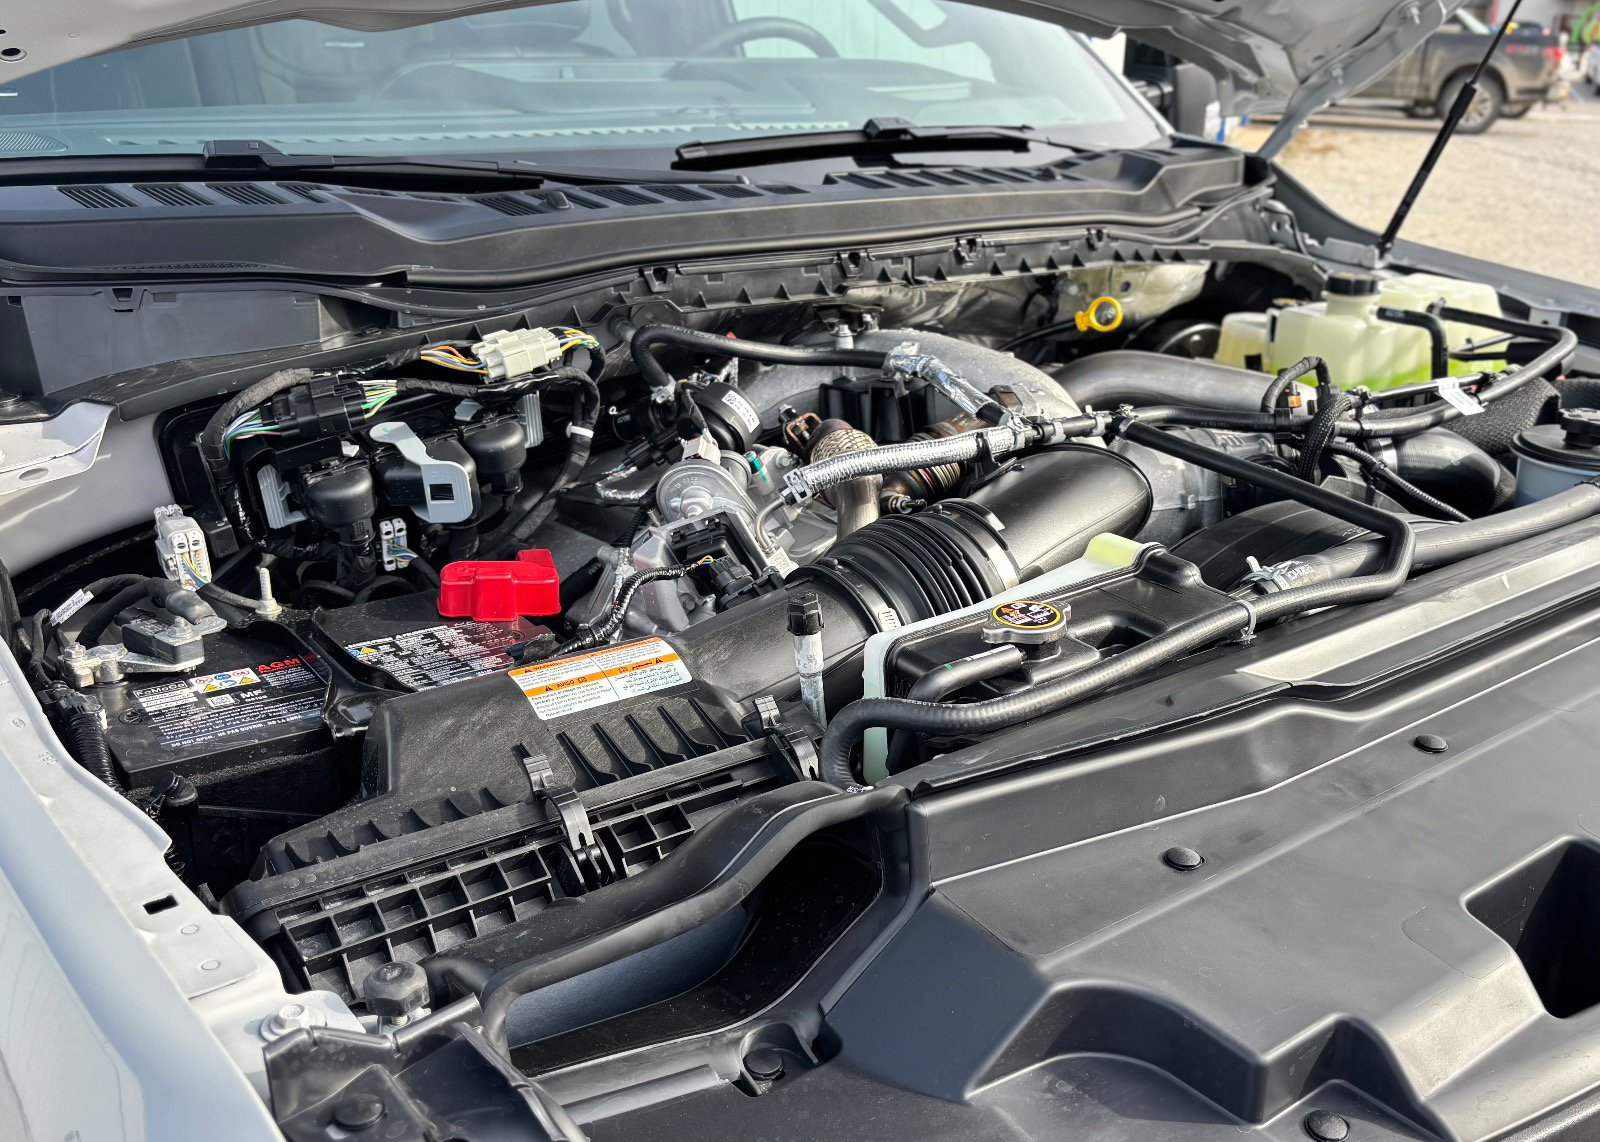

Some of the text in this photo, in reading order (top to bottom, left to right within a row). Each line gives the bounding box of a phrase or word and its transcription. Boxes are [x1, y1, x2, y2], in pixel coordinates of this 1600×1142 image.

[258, 658, 301, 673] AGM
[136, 683, 186, 697] FoMoCo
[557, 680, 575, 688] AVISO
